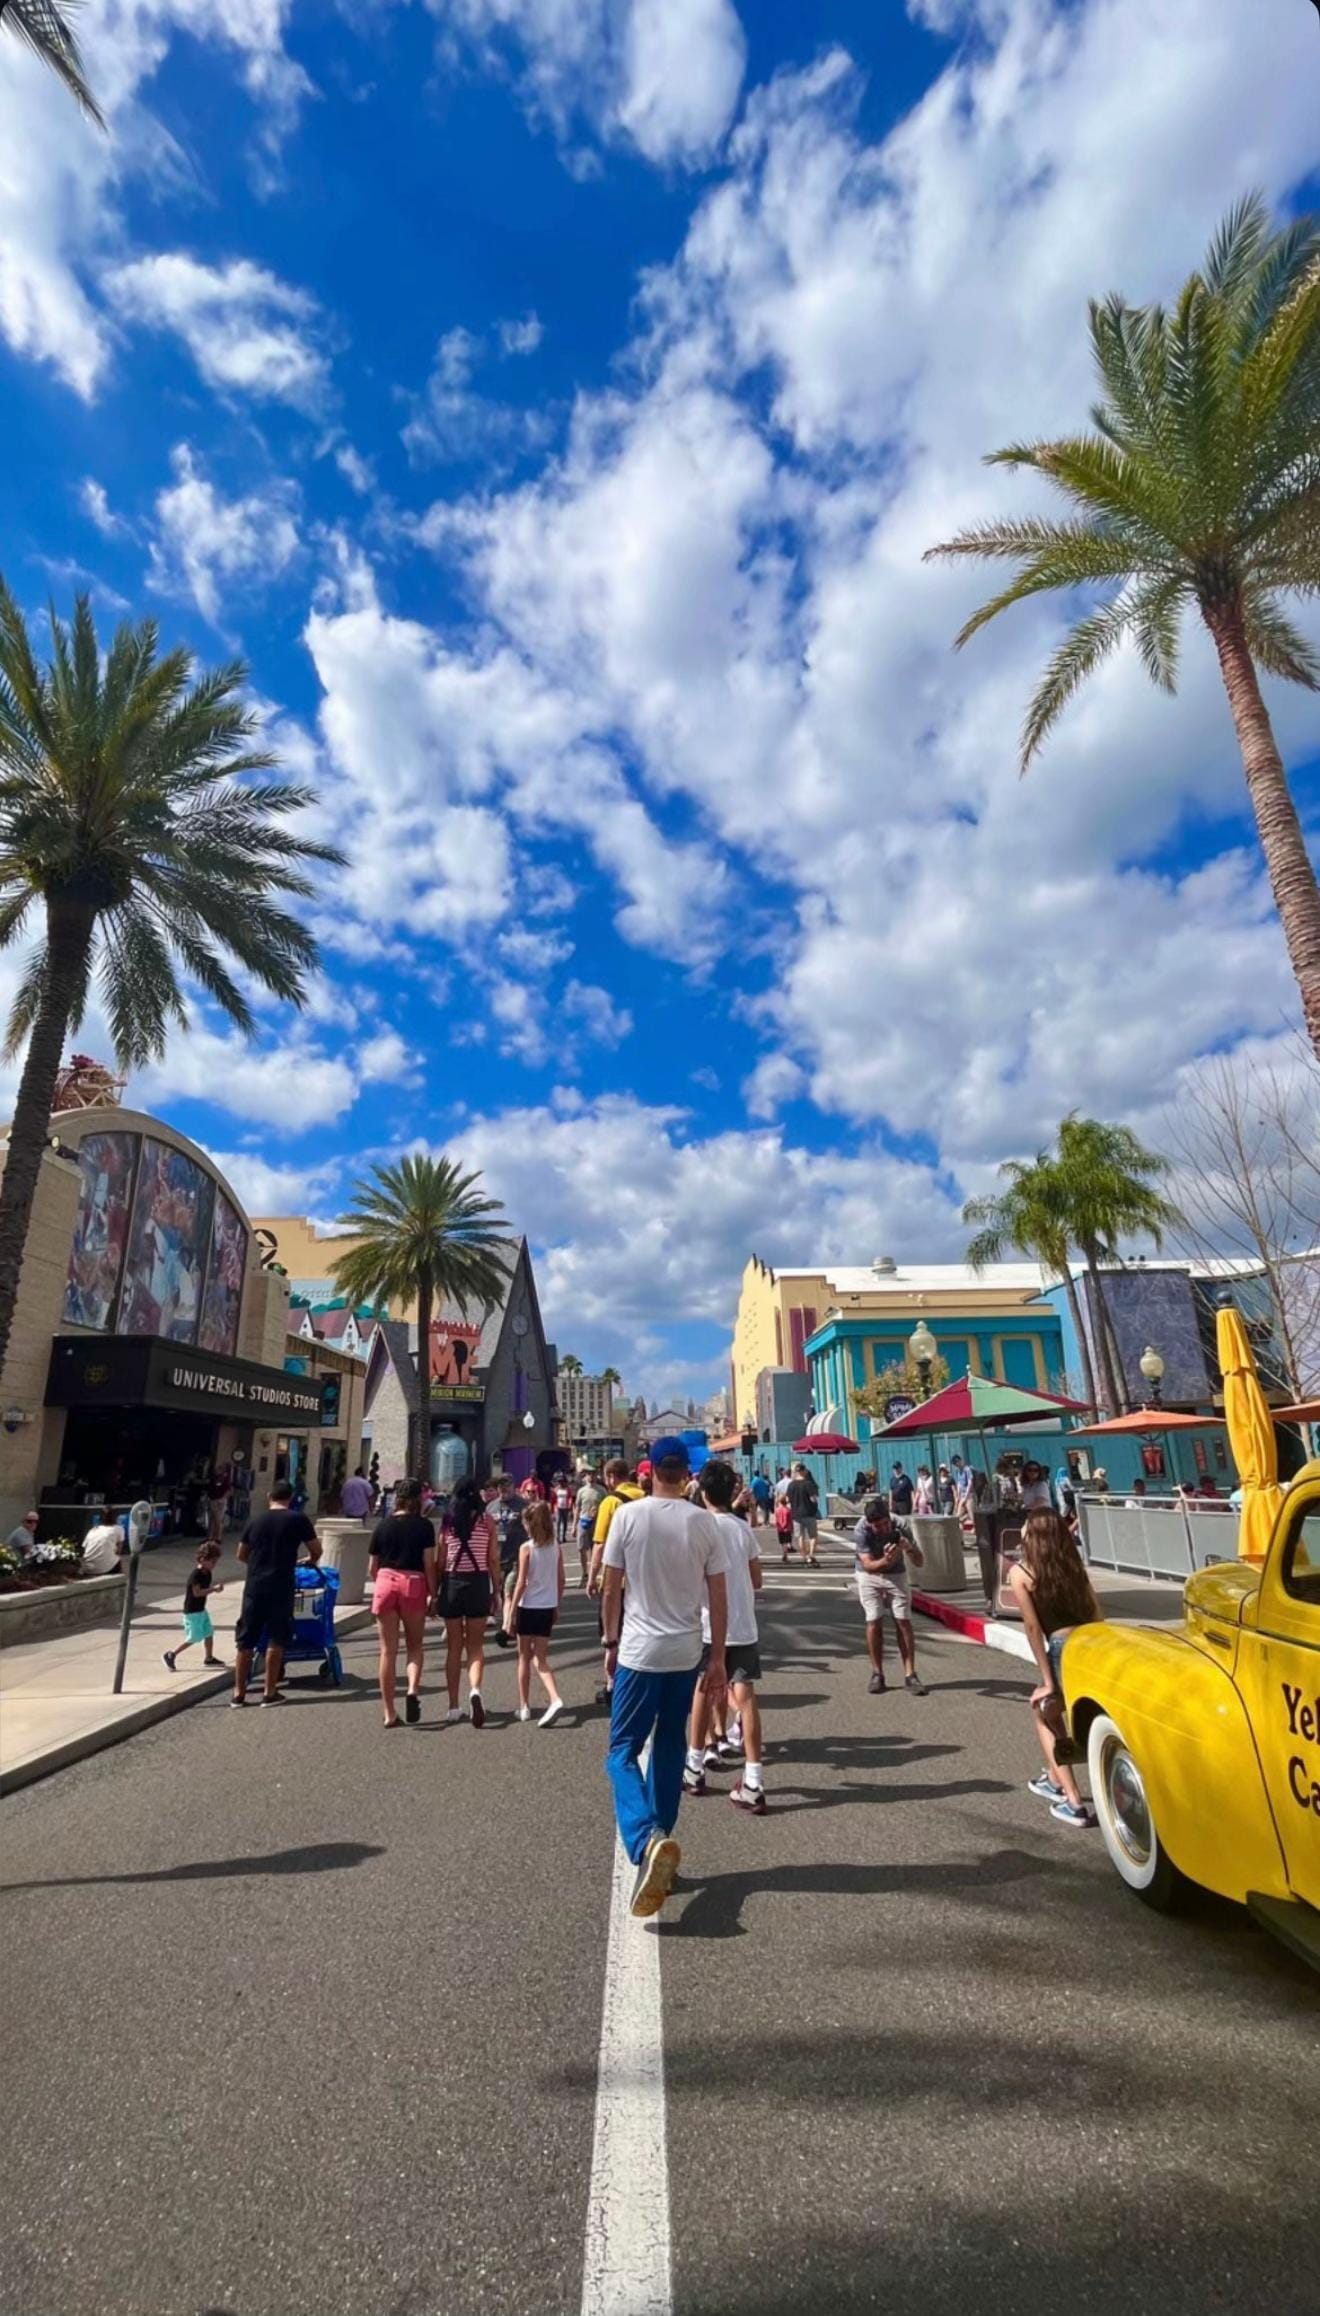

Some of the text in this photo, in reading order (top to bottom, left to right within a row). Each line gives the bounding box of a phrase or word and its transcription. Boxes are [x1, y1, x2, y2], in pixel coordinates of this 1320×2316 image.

[173, 1368, 320, 1412] UNIVERSAL STUDIOS STORE
